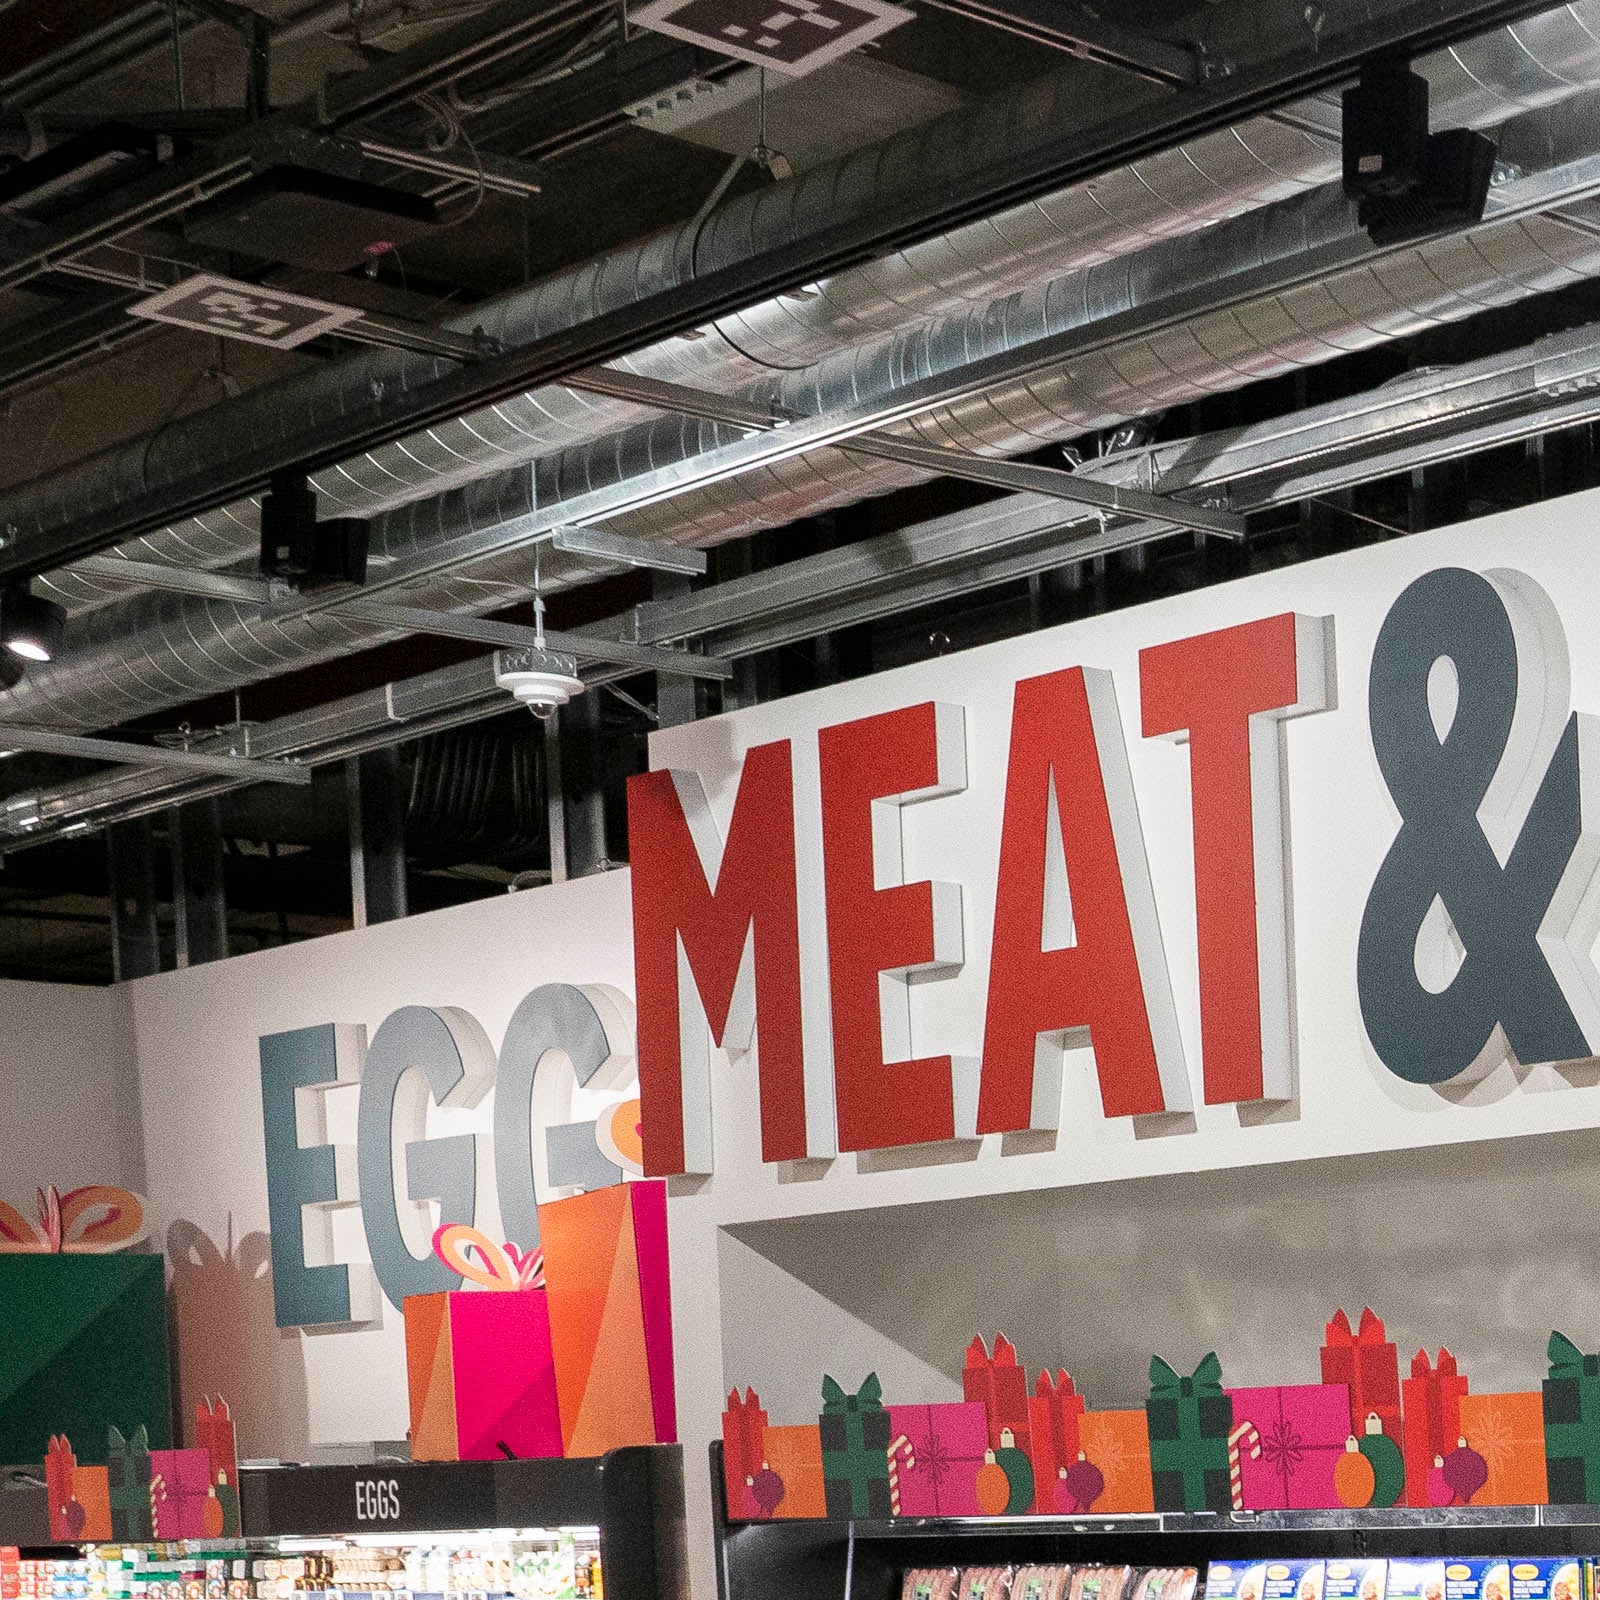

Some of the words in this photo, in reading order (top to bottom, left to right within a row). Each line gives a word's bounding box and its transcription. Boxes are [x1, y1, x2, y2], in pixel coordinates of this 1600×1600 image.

[626, 612, 1310, 1176] MEAT
[1357, 564, 1592, 1087] &
[258, 983, 632, 1327] EGG
[355, 1480, 400, 1521] EGGS
